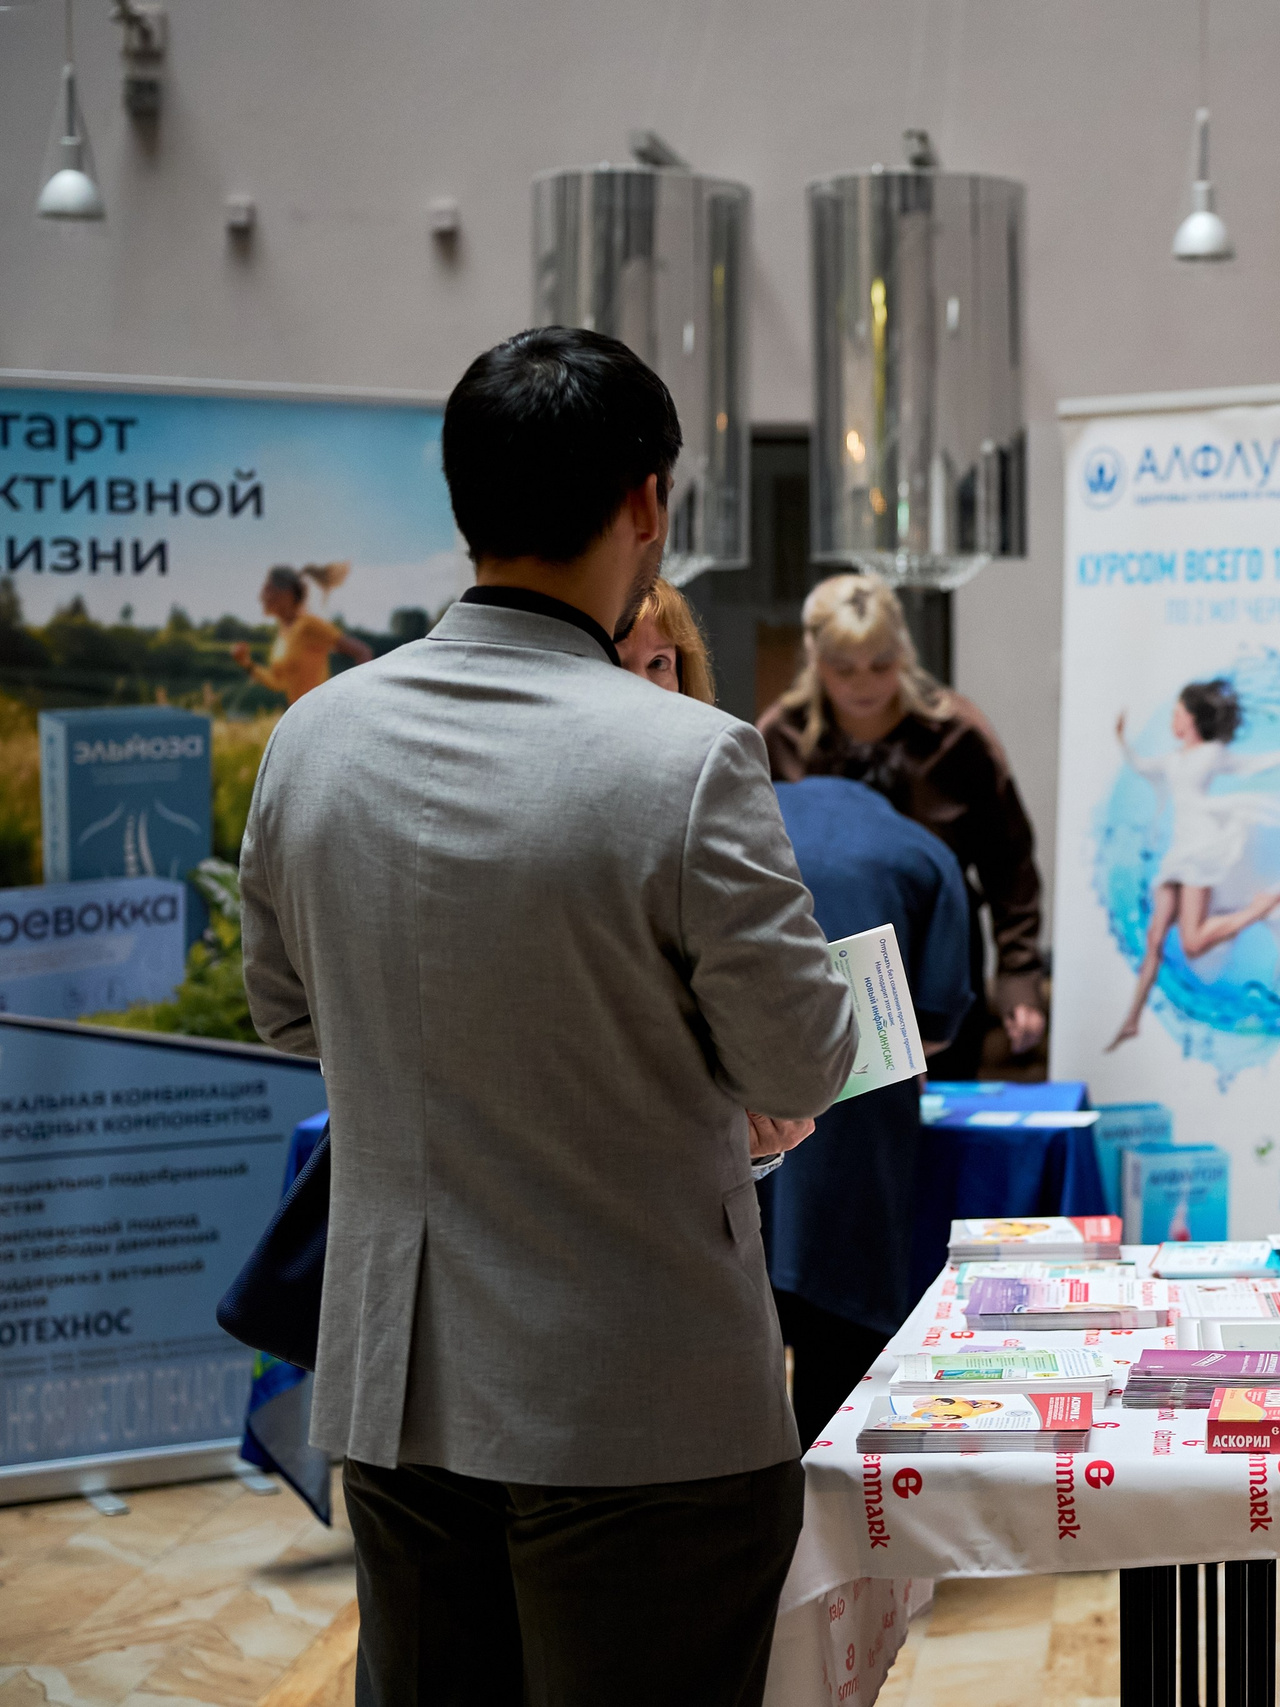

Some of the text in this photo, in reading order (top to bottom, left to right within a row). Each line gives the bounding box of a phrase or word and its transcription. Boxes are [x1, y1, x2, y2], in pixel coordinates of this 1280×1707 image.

[0, 535, 170, 577] изни
[1076, 551, 1177, 586] КУРСОМ
[1184, 546, 1265, 583] ВСЕГО
[875, 961, 883, 974] Нам
[878, 974, 888, 1000] подарит
[864, 976, 876, 1005] новый
[1212, 1435, 1271, 1448] АСКОРИЛ
[862, 1452, 891, 1549] enmark
[1055, 1452, 1081, 1541] nmark
[1249, 1453, 1273, 1533] nmark
